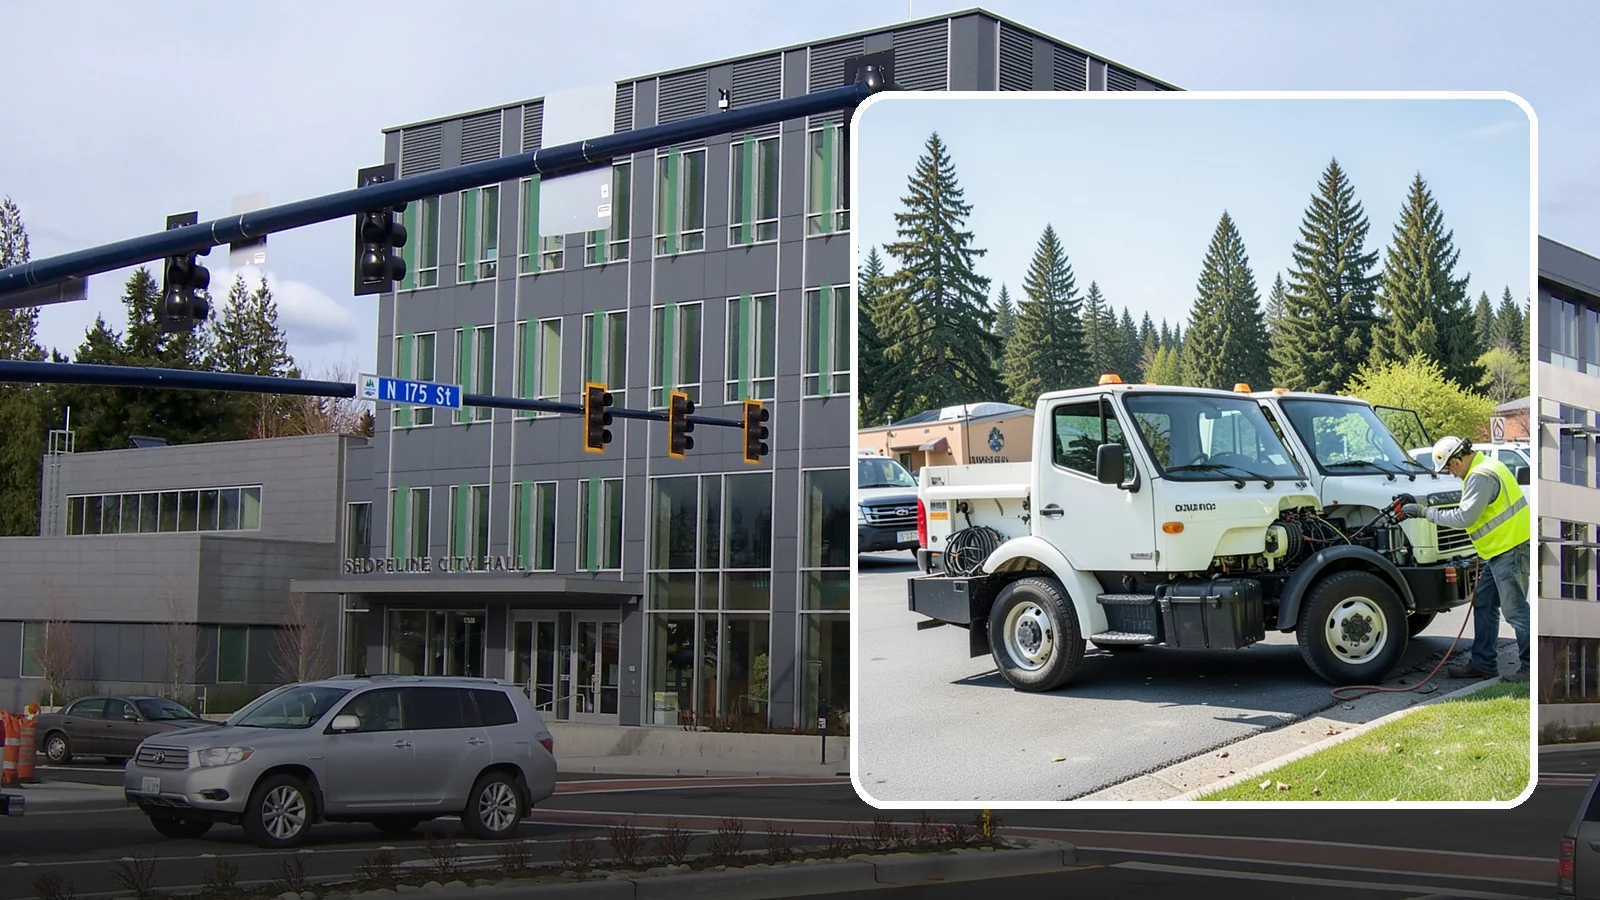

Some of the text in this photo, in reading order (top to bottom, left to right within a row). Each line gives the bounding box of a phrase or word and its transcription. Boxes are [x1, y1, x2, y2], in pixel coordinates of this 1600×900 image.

[387, 381, 451, 406] N 175 St
[344, 555, 525, 574] SHORELINE CITY HALL
